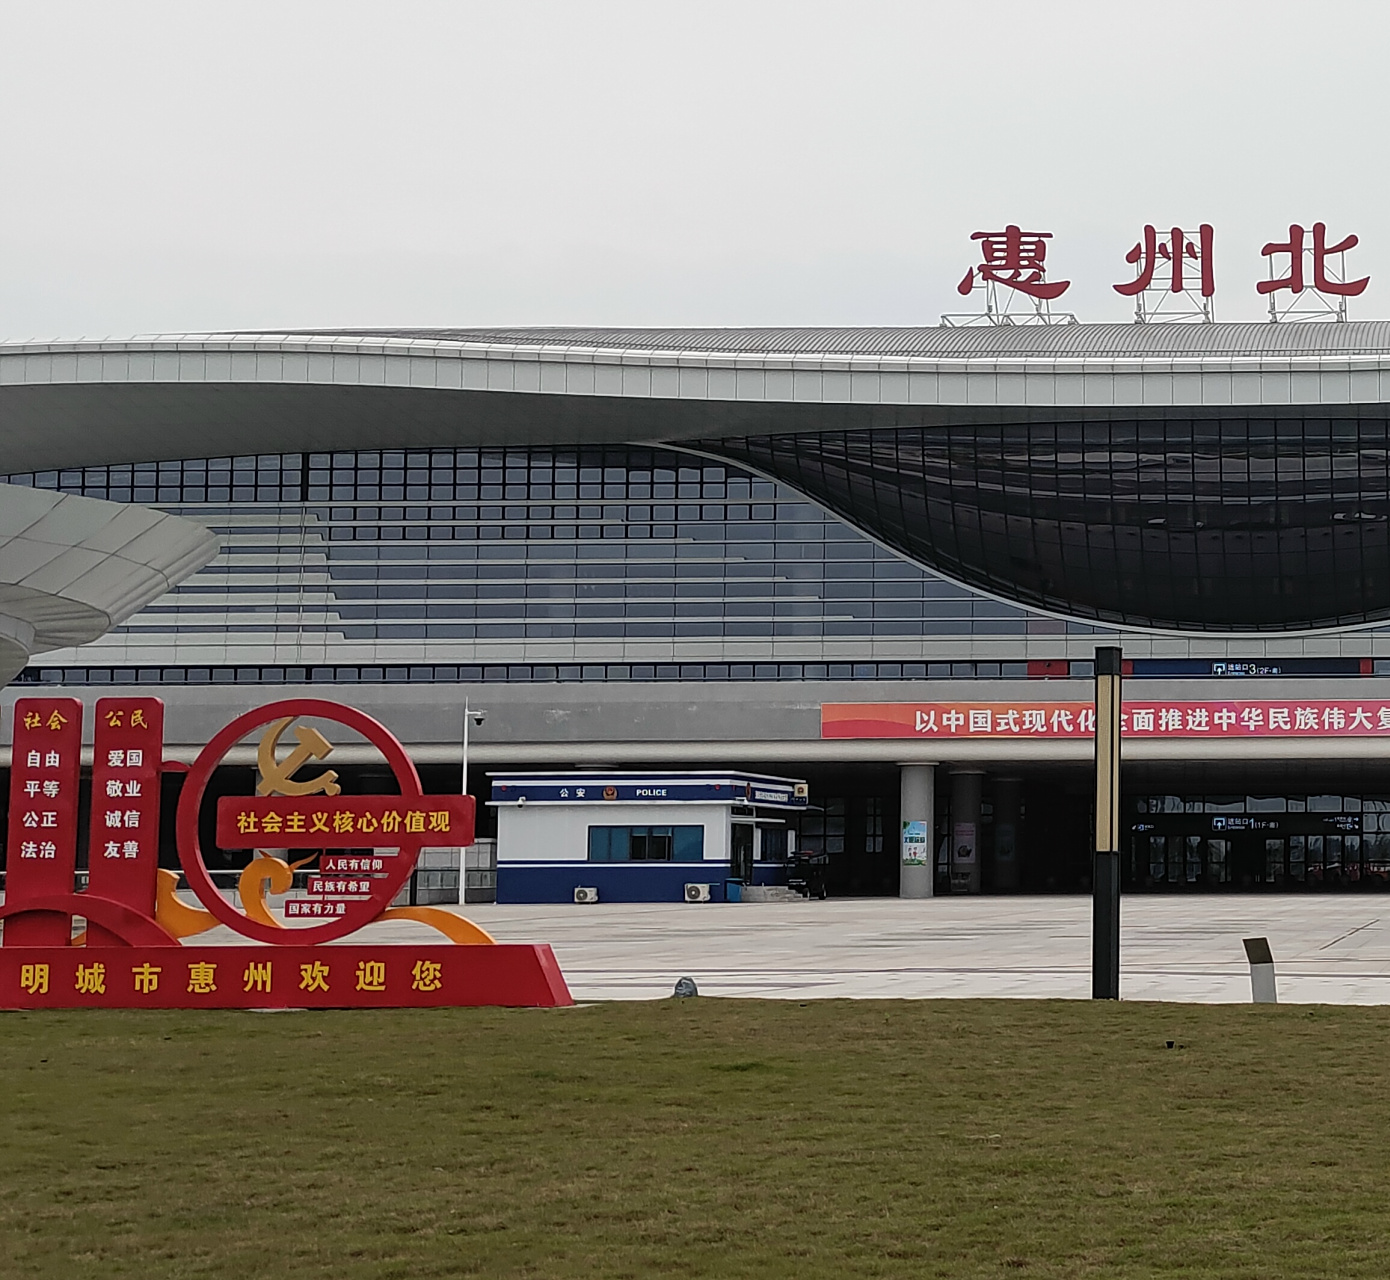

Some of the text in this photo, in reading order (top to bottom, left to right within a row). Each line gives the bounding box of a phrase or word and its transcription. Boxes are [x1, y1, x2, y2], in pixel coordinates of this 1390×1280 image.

[23, 709, 69, 731] 社会
[104, 709, 149, 730] 公民
[27, 750, 60, 768] 自由
[107, 750, 143, 767] 爱国
[24, 780, 60, 798] 平等
[106, 780, 142, 797] 敬业
[559, 787, 667, 798] 公安 POLICE
[22, 811, 58, 828] 公正
[104, 810, 141, 828] 诚信
[237, 810, 451, 833] 社会主义核心价值观
[20, 841, 57, 859] 法治
[103, 840, 139, 859] 友善
[325, 859, 383, 871] 人民有信仰
[288, 903, 346, 914] 国家有力量
[20, 960, 443, 994] 明城市惠州欢迎您
